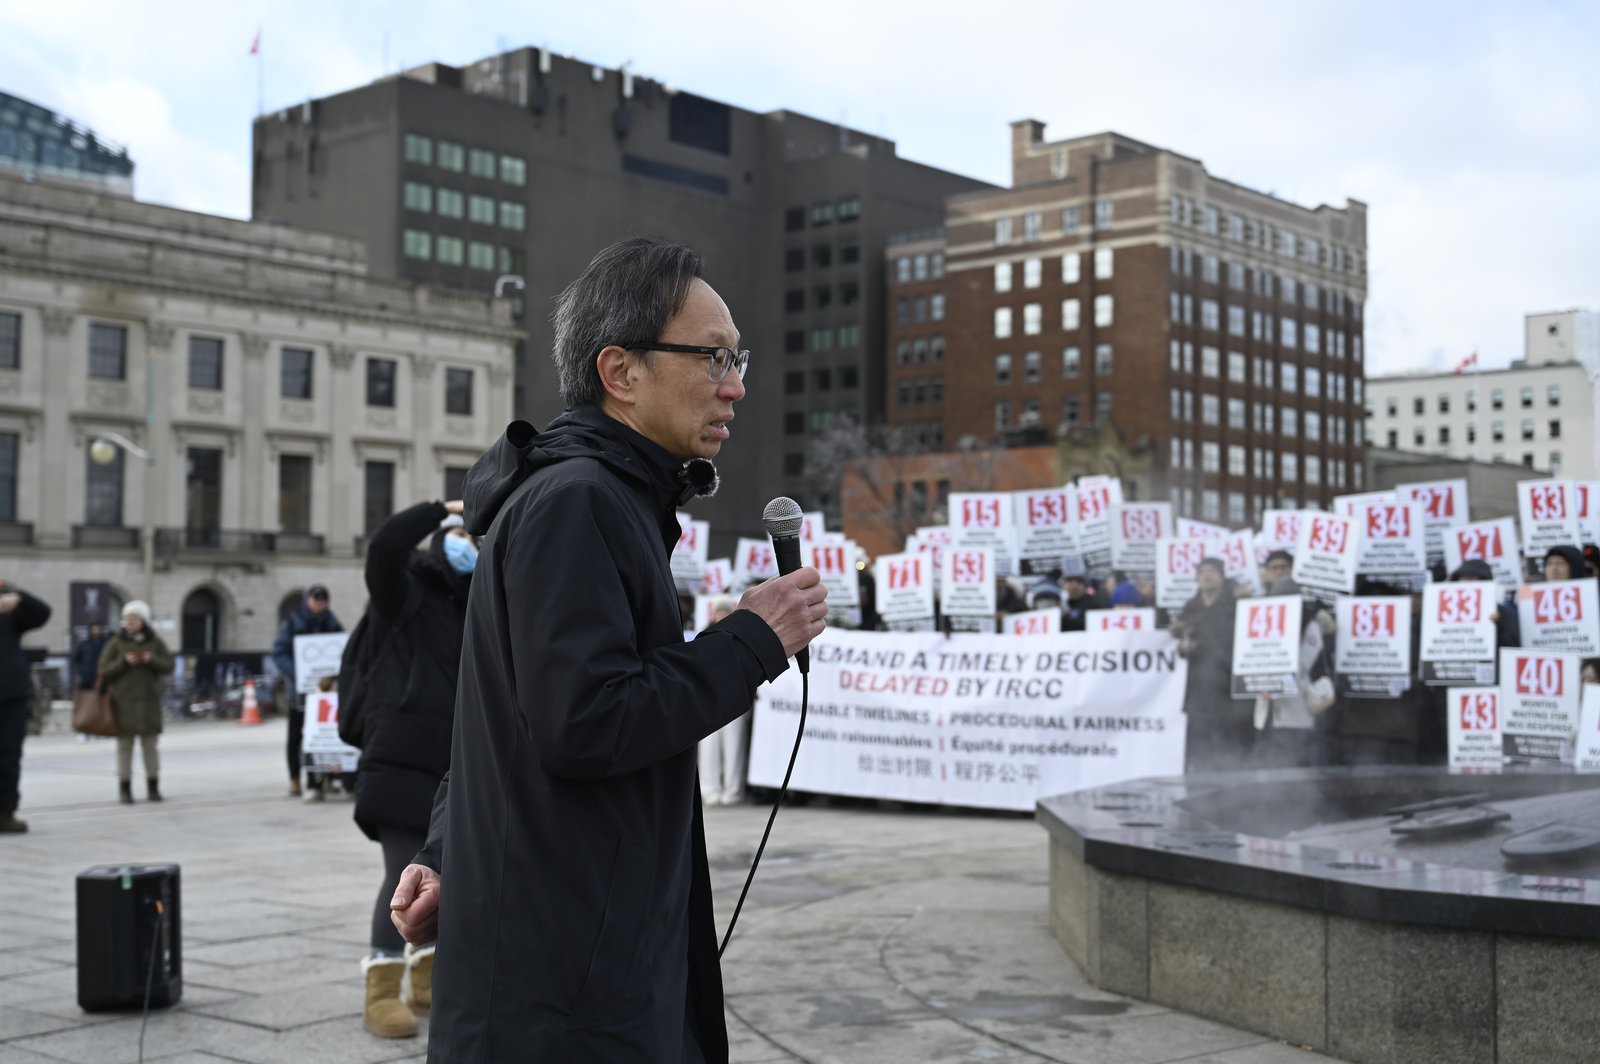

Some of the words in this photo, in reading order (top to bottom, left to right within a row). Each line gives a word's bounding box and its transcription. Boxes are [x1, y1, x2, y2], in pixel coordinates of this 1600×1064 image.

[962, 498, 1000, 528] 15
[1029, 494, 1067, 526] 53
[1529, 485, 1566, 520] 33
[1309, 516, 1348, 554] 39
[1367, 505, 1410, 537] 34
[1458, 525, 1503, 561] 27
[953, 552, 984, 583] 53
[1248, 604, 1286, 638] 41
[1352, 604, 1395, 637] 81
[1438, 588, 1481, 623] 33
[1533, 586, 1582, 624] 46
[911, 651, 927, 670] A
[938, 651, 1029, 673] TIMELY
[1035, 649, 1177, 673] DECISION
[1516, 656, 1563, 696] 40
[838, 669, 948, 697] DELAYED
[956, 677, 989, 697] BY
[995, 678, 1063, 700] IRCC
[855, 705, 930, 723] TIMELINES
[949, 711, 1067, 731] PROCEDURAL
[1073, 714, 1165, 732] FAIRNESS
[1460, 693, 1496, 730] 43
[951, 734, 1004, 754] Équité
[1009, 741, 1118, 758] procédurale
